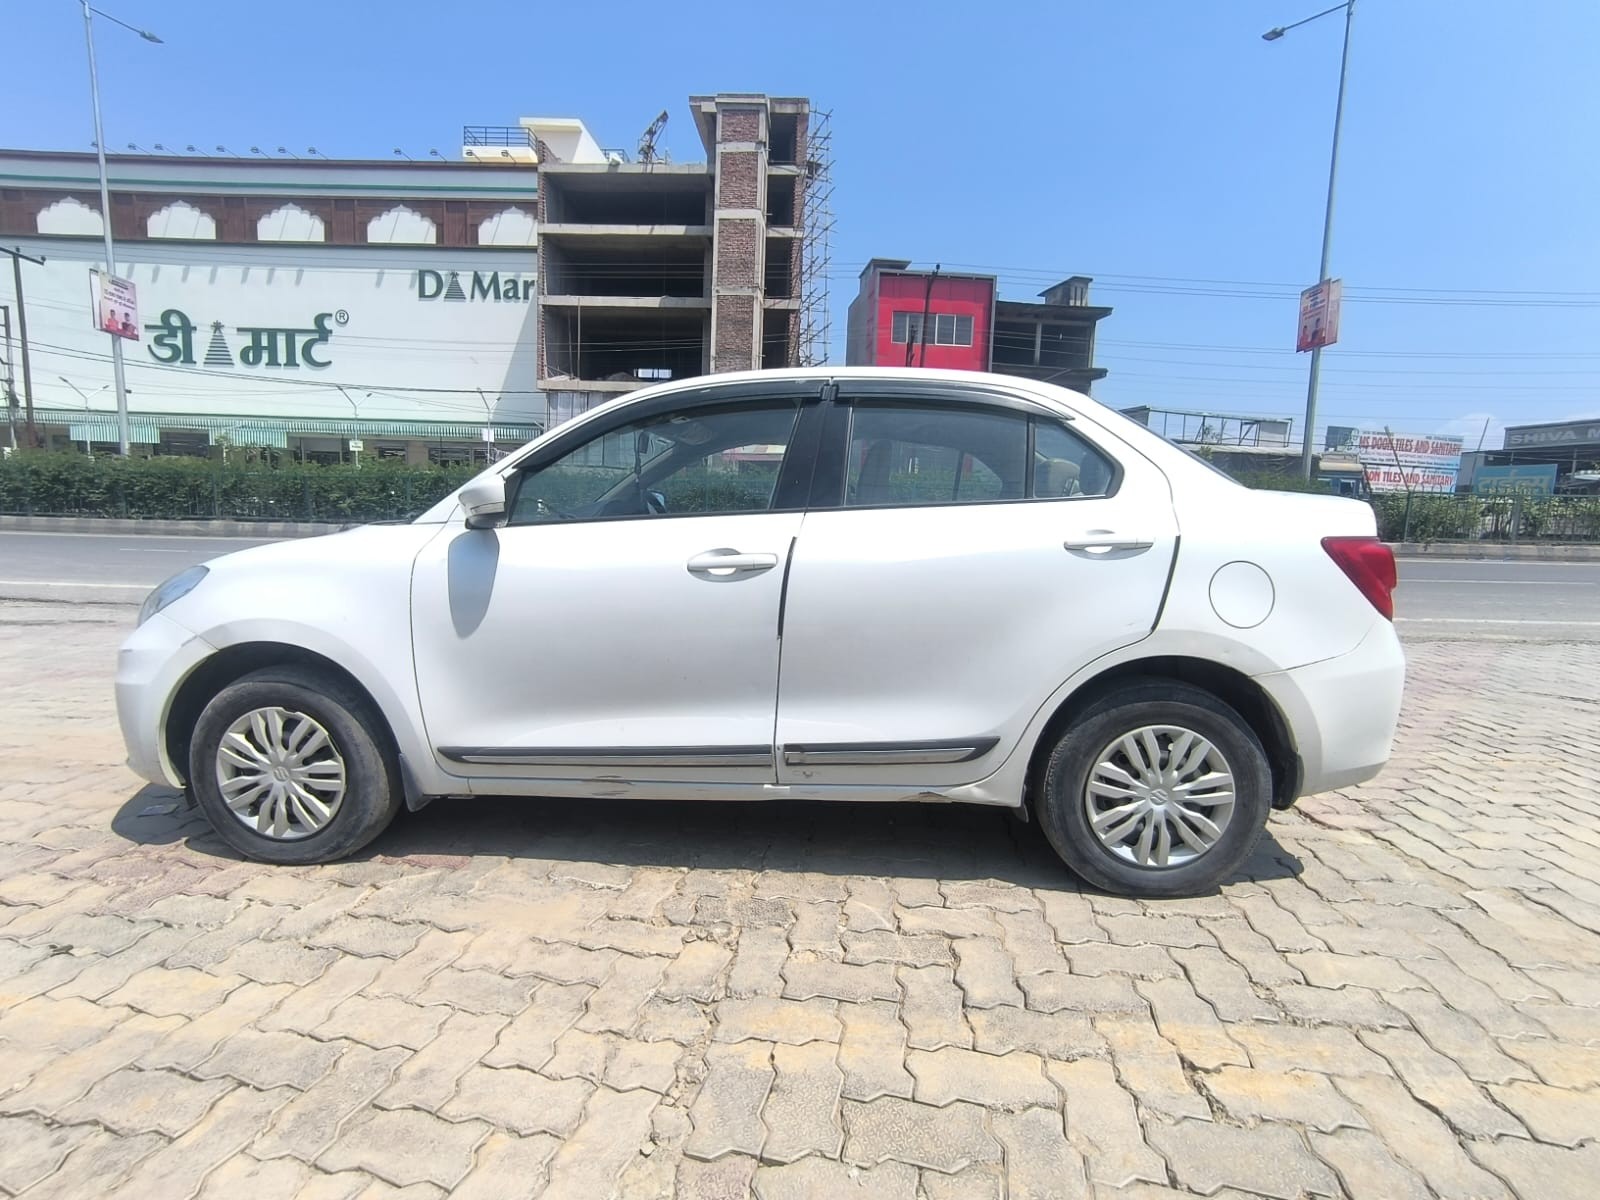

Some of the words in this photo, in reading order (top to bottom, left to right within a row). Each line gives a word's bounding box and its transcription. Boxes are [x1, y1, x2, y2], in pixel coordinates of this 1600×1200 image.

[236, 312, 333, 367] मार्ट
[1509, 430, 1577, 444] SHIVA
[1396, 438, 1414, 452] TILES
[1415, 440, 1430, 454] AND
[1431, 441, 1462, 456] SANITARY
[1383, 471, 1402, 483] TILES
[1405, 473, 1421, 484] AND
[1422, 474, 1453, 486] SANITARY
